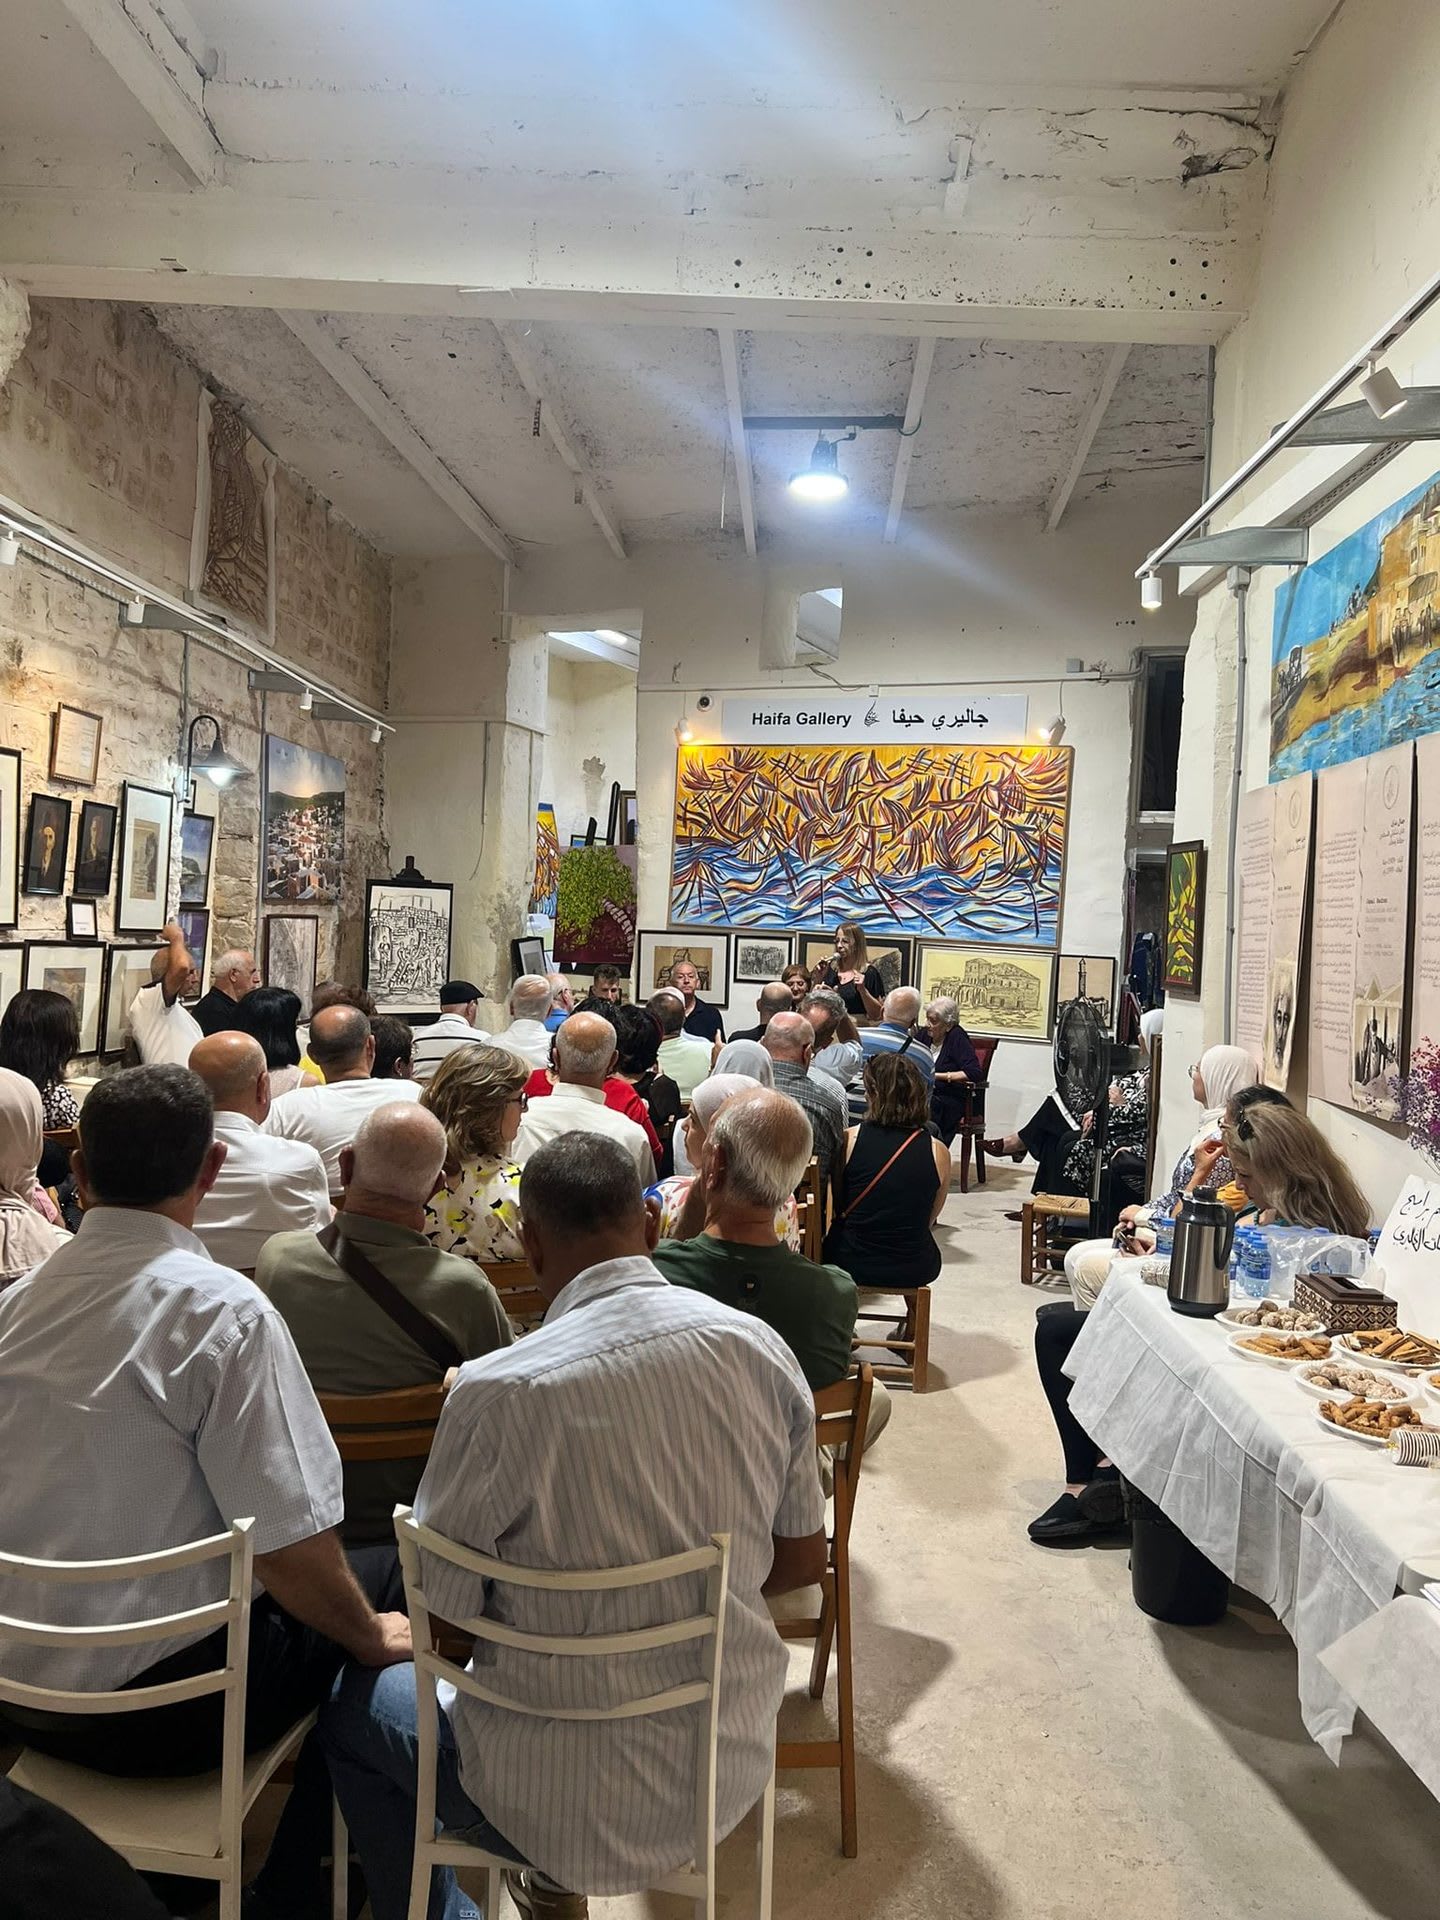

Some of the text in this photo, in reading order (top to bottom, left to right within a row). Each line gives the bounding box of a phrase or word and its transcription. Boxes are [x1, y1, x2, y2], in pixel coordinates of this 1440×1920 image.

[752, 712, 791, 725] Haifa
[796, 712, 852, 728] Gallery
[892, 708, 925, 728] حيفا
[932, 708, 989, 731] جاليري
